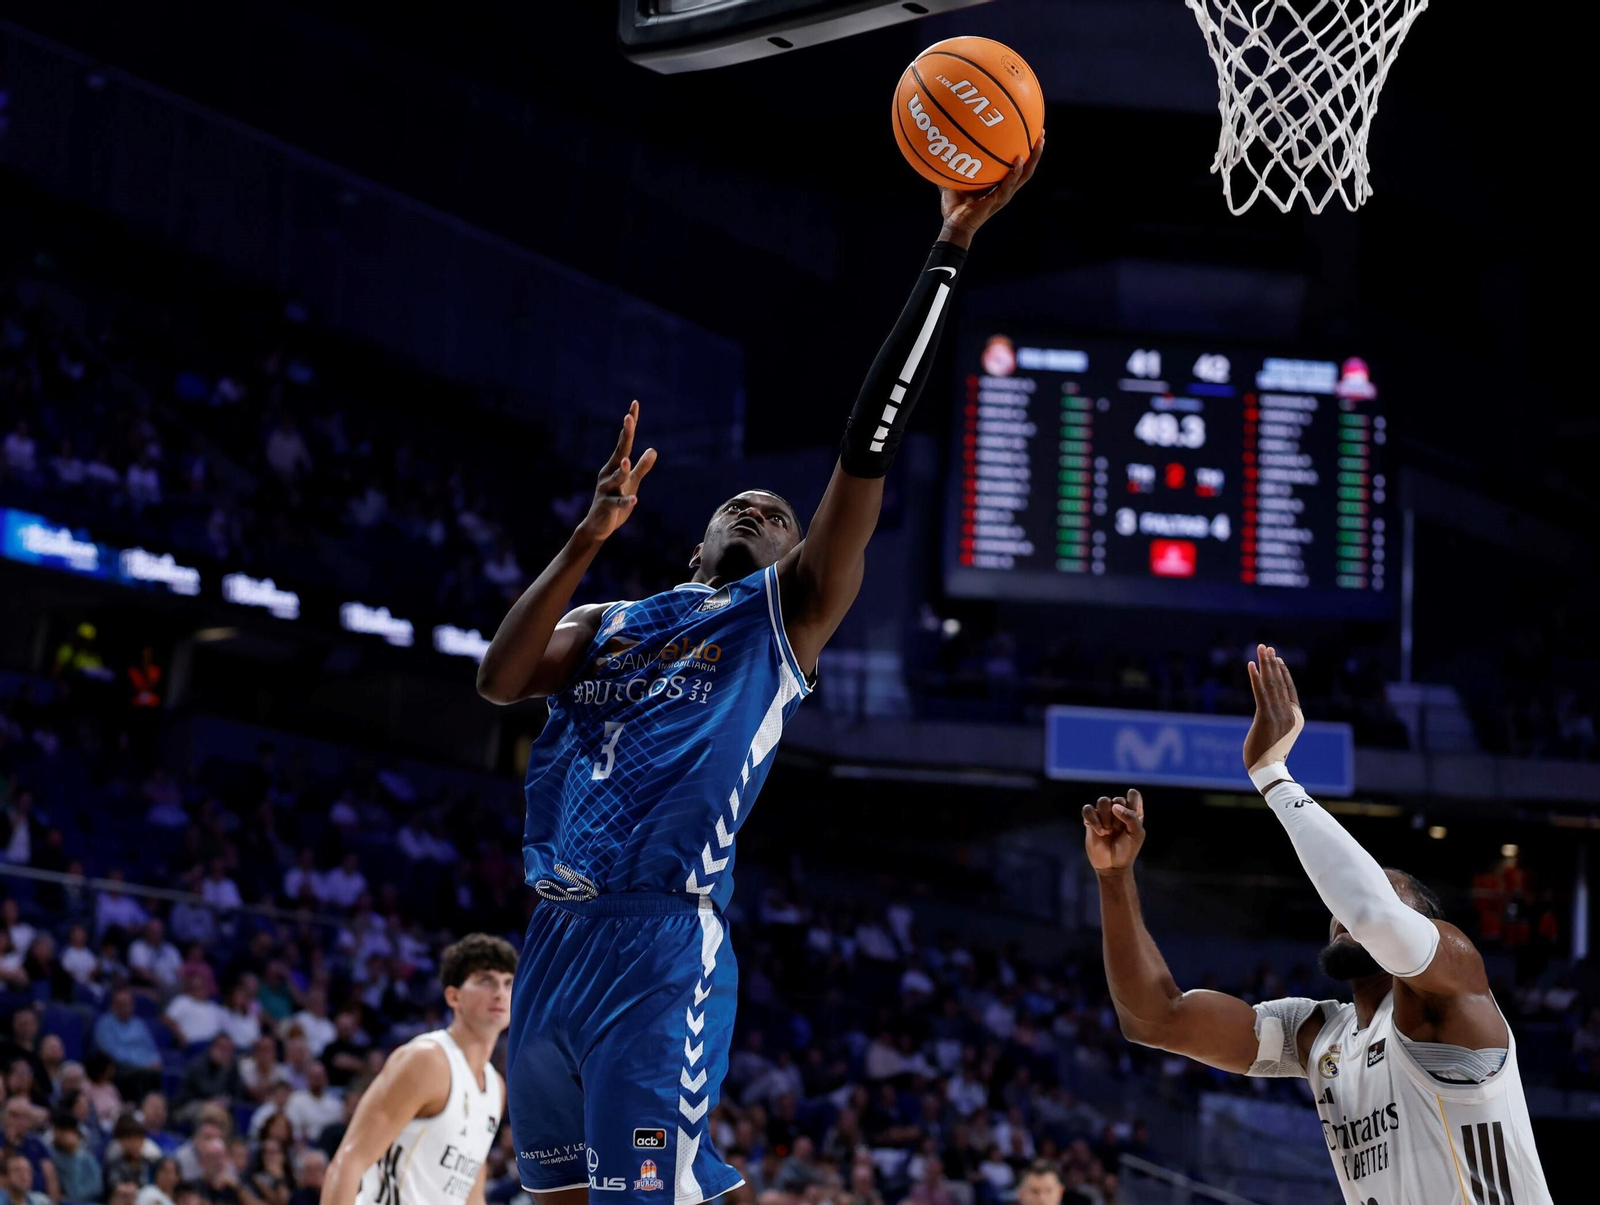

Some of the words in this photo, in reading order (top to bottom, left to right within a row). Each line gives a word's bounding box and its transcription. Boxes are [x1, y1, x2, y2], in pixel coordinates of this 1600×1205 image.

[935, 74, 952, 89] NXT
[907, 92, 983, 179] Wilson
[1126, 348, 1162, 379] 41
[1210, 513, 1231, 542] 4
[611, 653, 651, 670] SAN
[660, 637, 722, 662] ablo
[658, 660, 717, 673] INMOBILIARIA
[591, 721, 625, 781] 3
[636, 1136, 659, 1147] acb
[520, 1148, 561, 1160] CASTILLA
[563, 1145, 570, 1154] Y
[550, 1154, 578, 1164] IMPULSA
[588, 1173, 627, 1191] XUS
